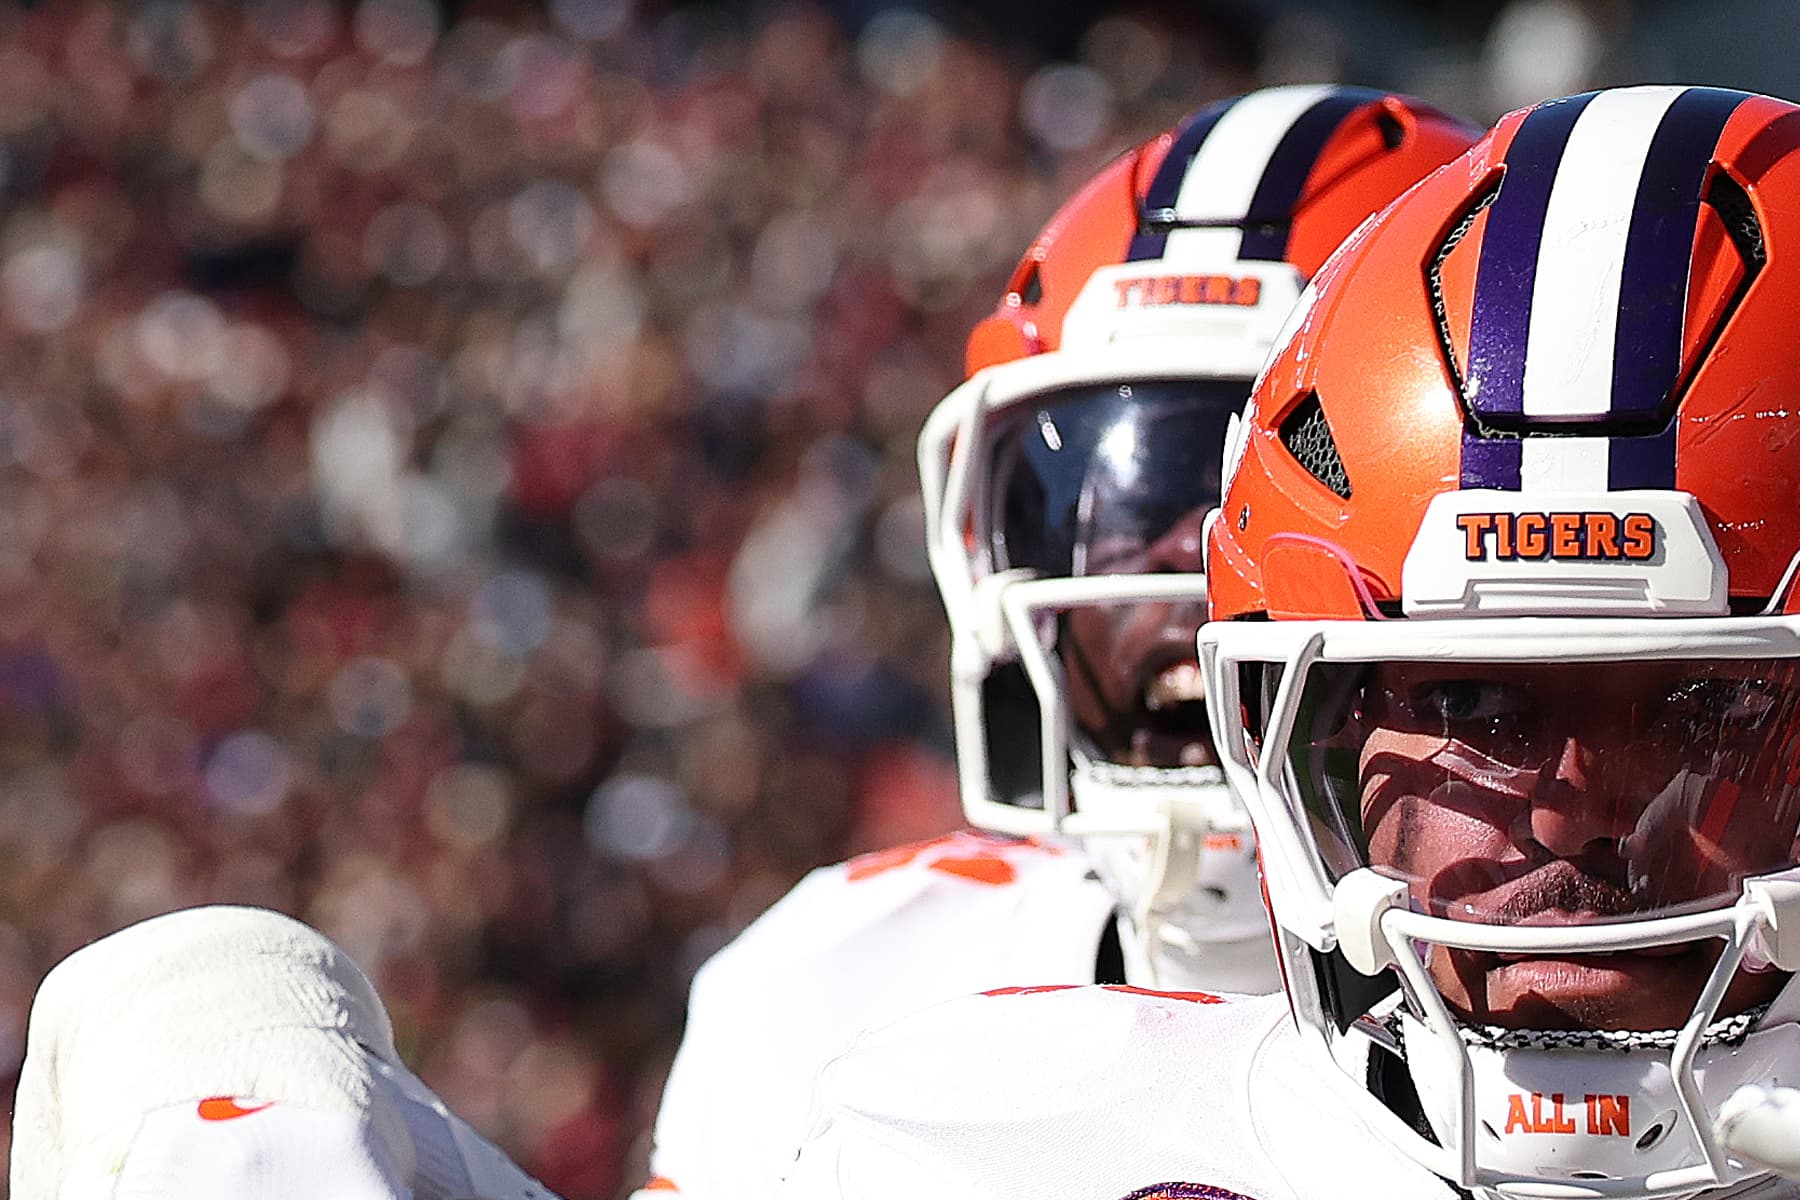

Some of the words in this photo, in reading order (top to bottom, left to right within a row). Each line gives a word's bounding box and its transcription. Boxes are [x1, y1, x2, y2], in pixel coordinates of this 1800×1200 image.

[1115, 275, 1261, 308] TIGERS
[1456, 511, 1656, 562] TIGERS
[1504, 1092, 1576, 1135] ALL
[1584, 1093, 1630, 1137] IN
